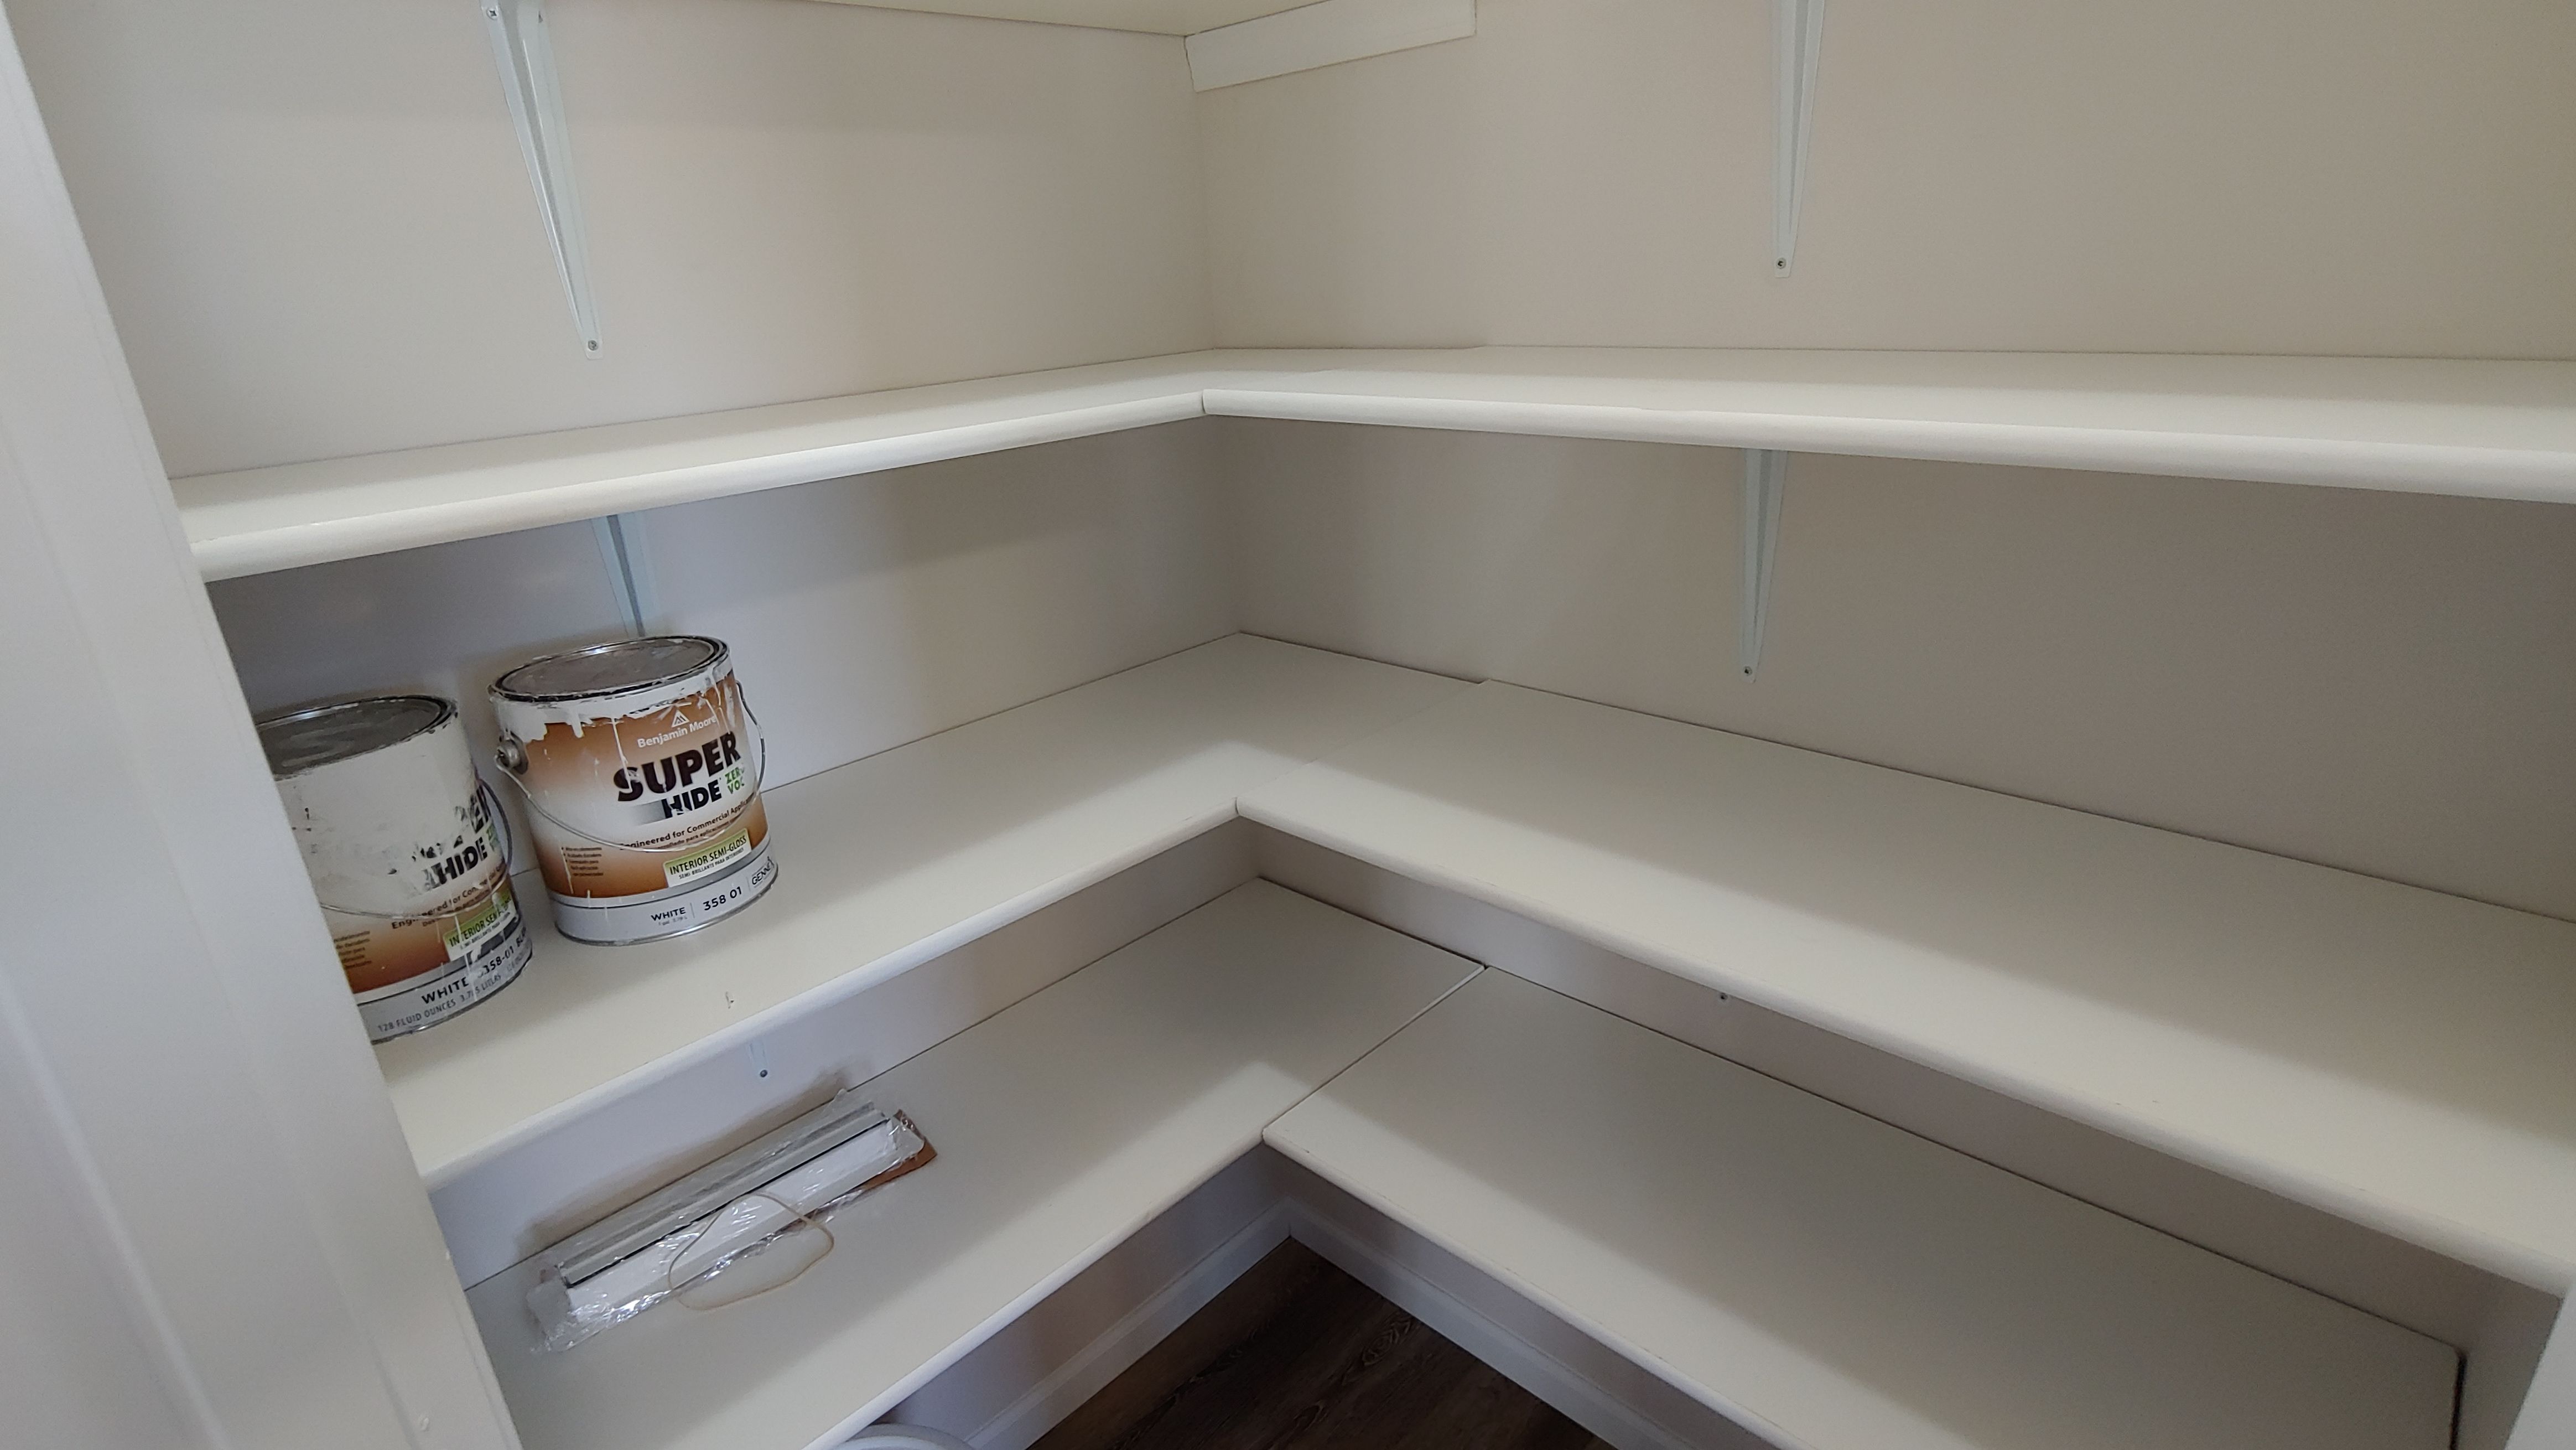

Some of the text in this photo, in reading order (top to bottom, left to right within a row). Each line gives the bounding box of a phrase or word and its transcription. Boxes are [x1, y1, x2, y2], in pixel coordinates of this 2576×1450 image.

[637, 715, 718, 748] Benjamin Moore
[613, 731, 741, 801] SUPER
[661, 779, 721, 819] HIDE
[619, 832, 671, 851] gineered
[672, 830, 685, 838] for
[687, 810, 730, 833] Commercial
[431, 836, 488, 885] HIDE
[669, 835, 747, 876] INTERIOR SEMI-GLOSS
[391, 900, 448, 929] Engeered
[651, 907, 686, 921] WHITE
[703, 894, 726, 911] 358
[730, 886, 742, 899] 01
[422, 977, 469, 1004] WHITE
[378, 1022, 394, 1033] 128
[396, 1012, 422, 1028] FLUID
[424, 998, 456, 1018] OUNCES
